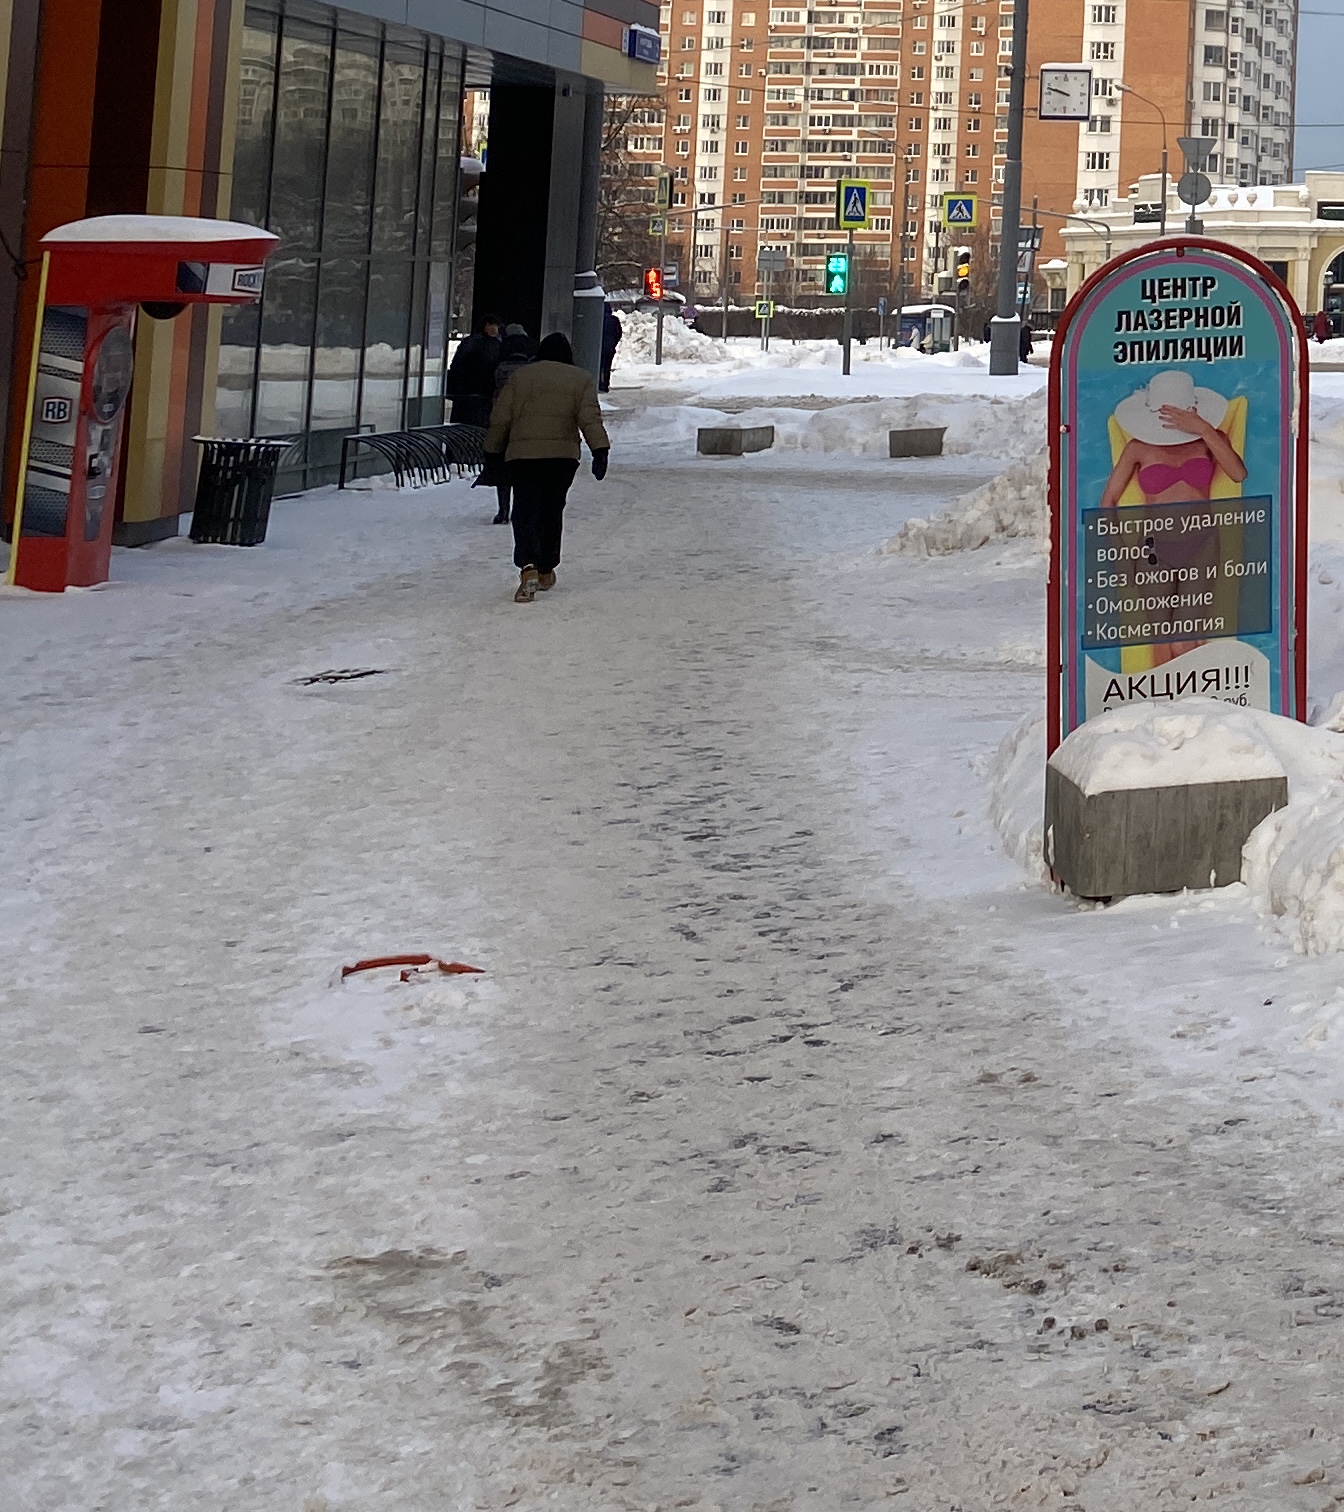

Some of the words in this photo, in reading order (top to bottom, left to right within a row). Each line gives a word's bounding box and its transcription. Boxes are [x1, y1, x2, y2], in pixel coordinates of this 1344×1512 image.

[1141, 276, 1217, 304] ЦЕНТР
[1114, 300, 1242, 333] ЛАЗЕРНОЙ
[1113, 335, 1245, 364] ЭПИЛЯЦИИ
[45, 400, 68, 420] RB
[1096, 516, 1174, 536] Быстрое
[1180, 509, 1266, 534] удаление
[1096, 545, 1150, 562] волос
[1096, 570, 1128, 588] Без
[1135, 567, 1199, 586] ожогов
[1206, 565, 1217, 579] и
[1224, 560, 1267, 578] боли
[1096, 591, 1214, 615] Омоложение
[1096, 616, 1225, 641] Косметология
[1103, 665, 1251, 703] АКЦИЯ!!!
